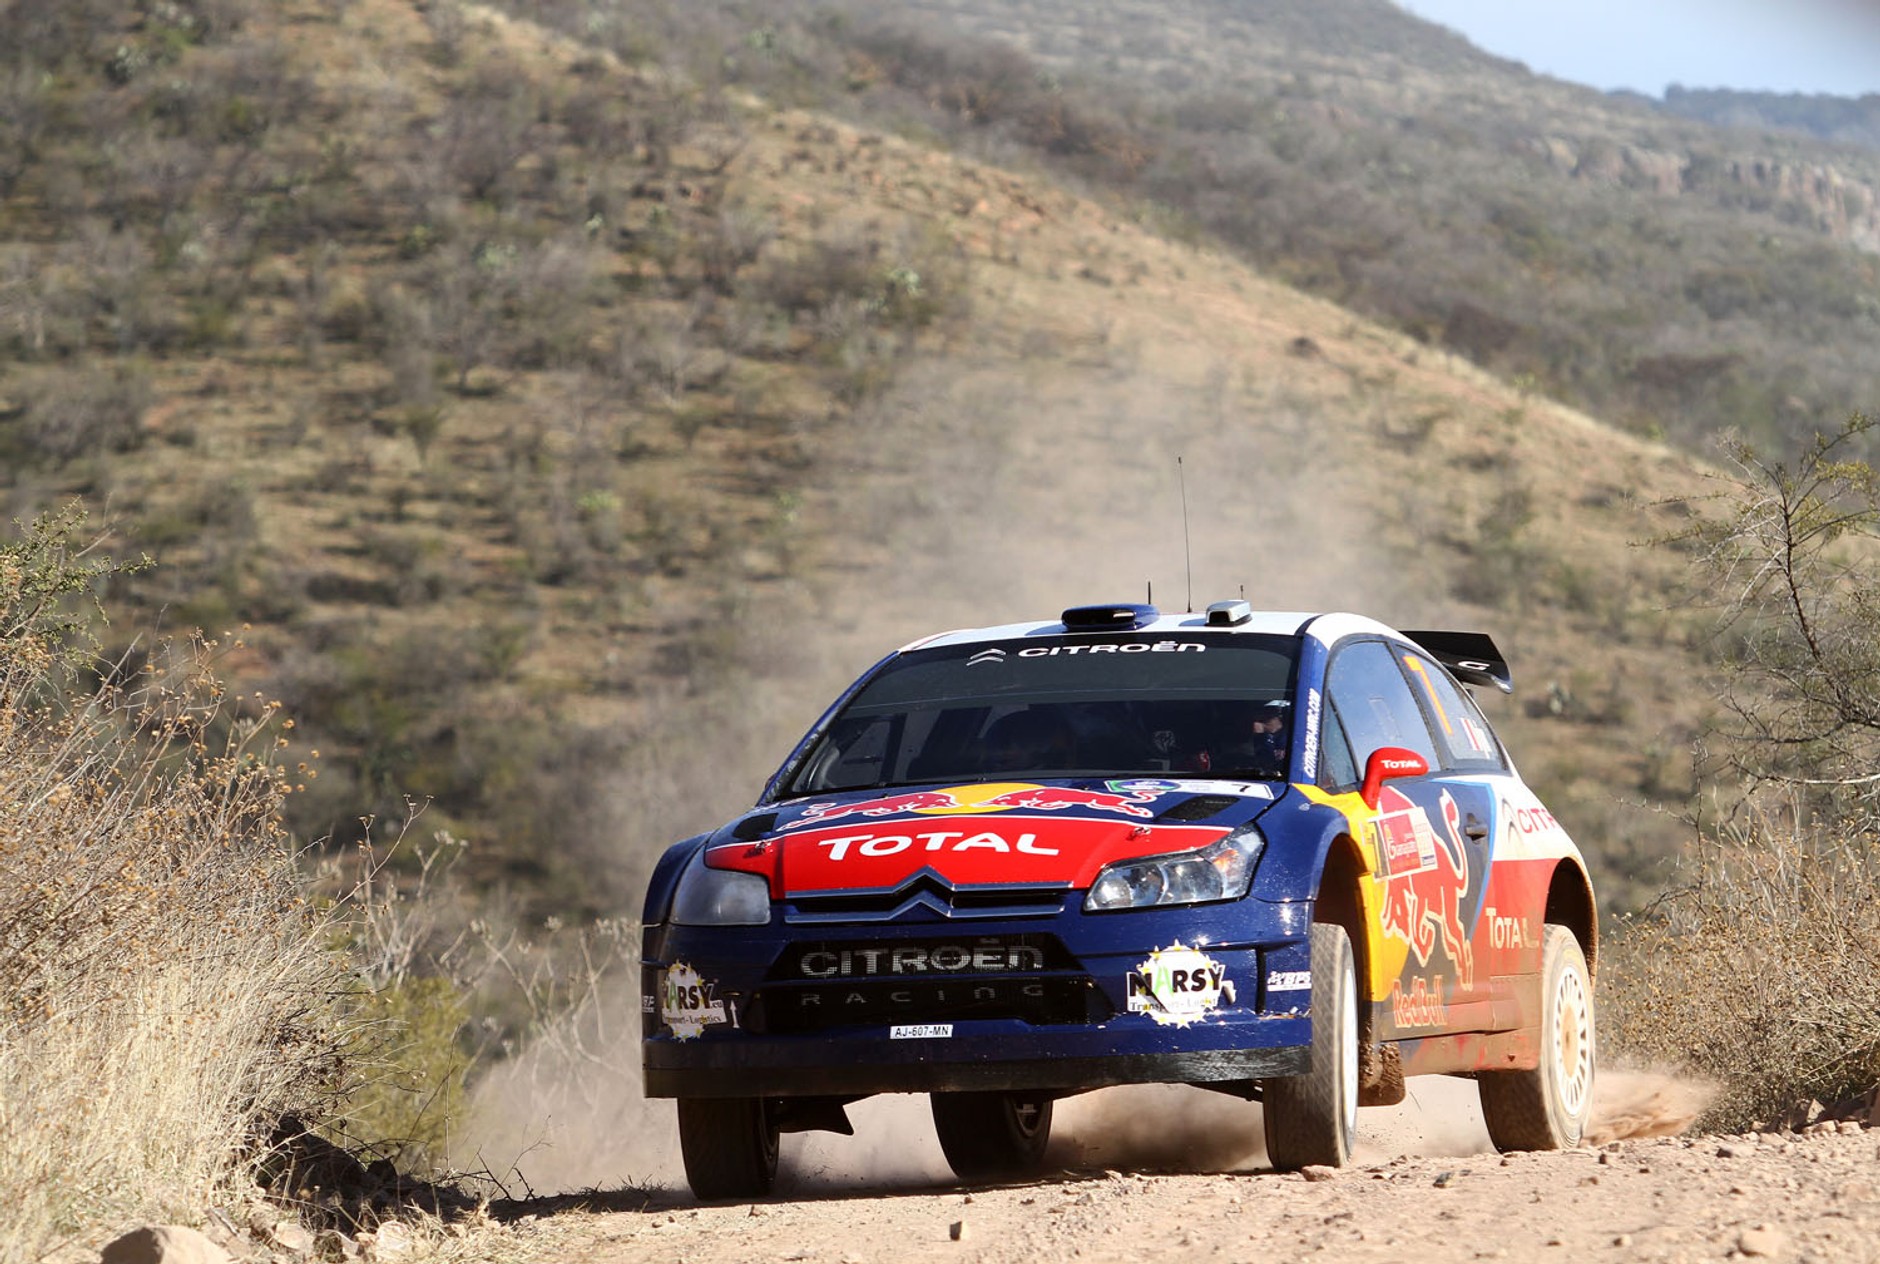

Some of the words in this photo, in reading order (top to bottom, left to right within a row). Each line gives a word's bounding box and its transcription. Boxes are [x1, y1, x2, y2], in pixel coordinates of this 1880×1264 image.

[1380, 759, 1422, 769] TOTAL
[818, 832, 1060, 861] TOTAL
[1485, 907, 1540, 949] TOTAL
[801, 984, 1044, 1005] RACING
[894, 1026, 950, 1037] AJ-607-MN
